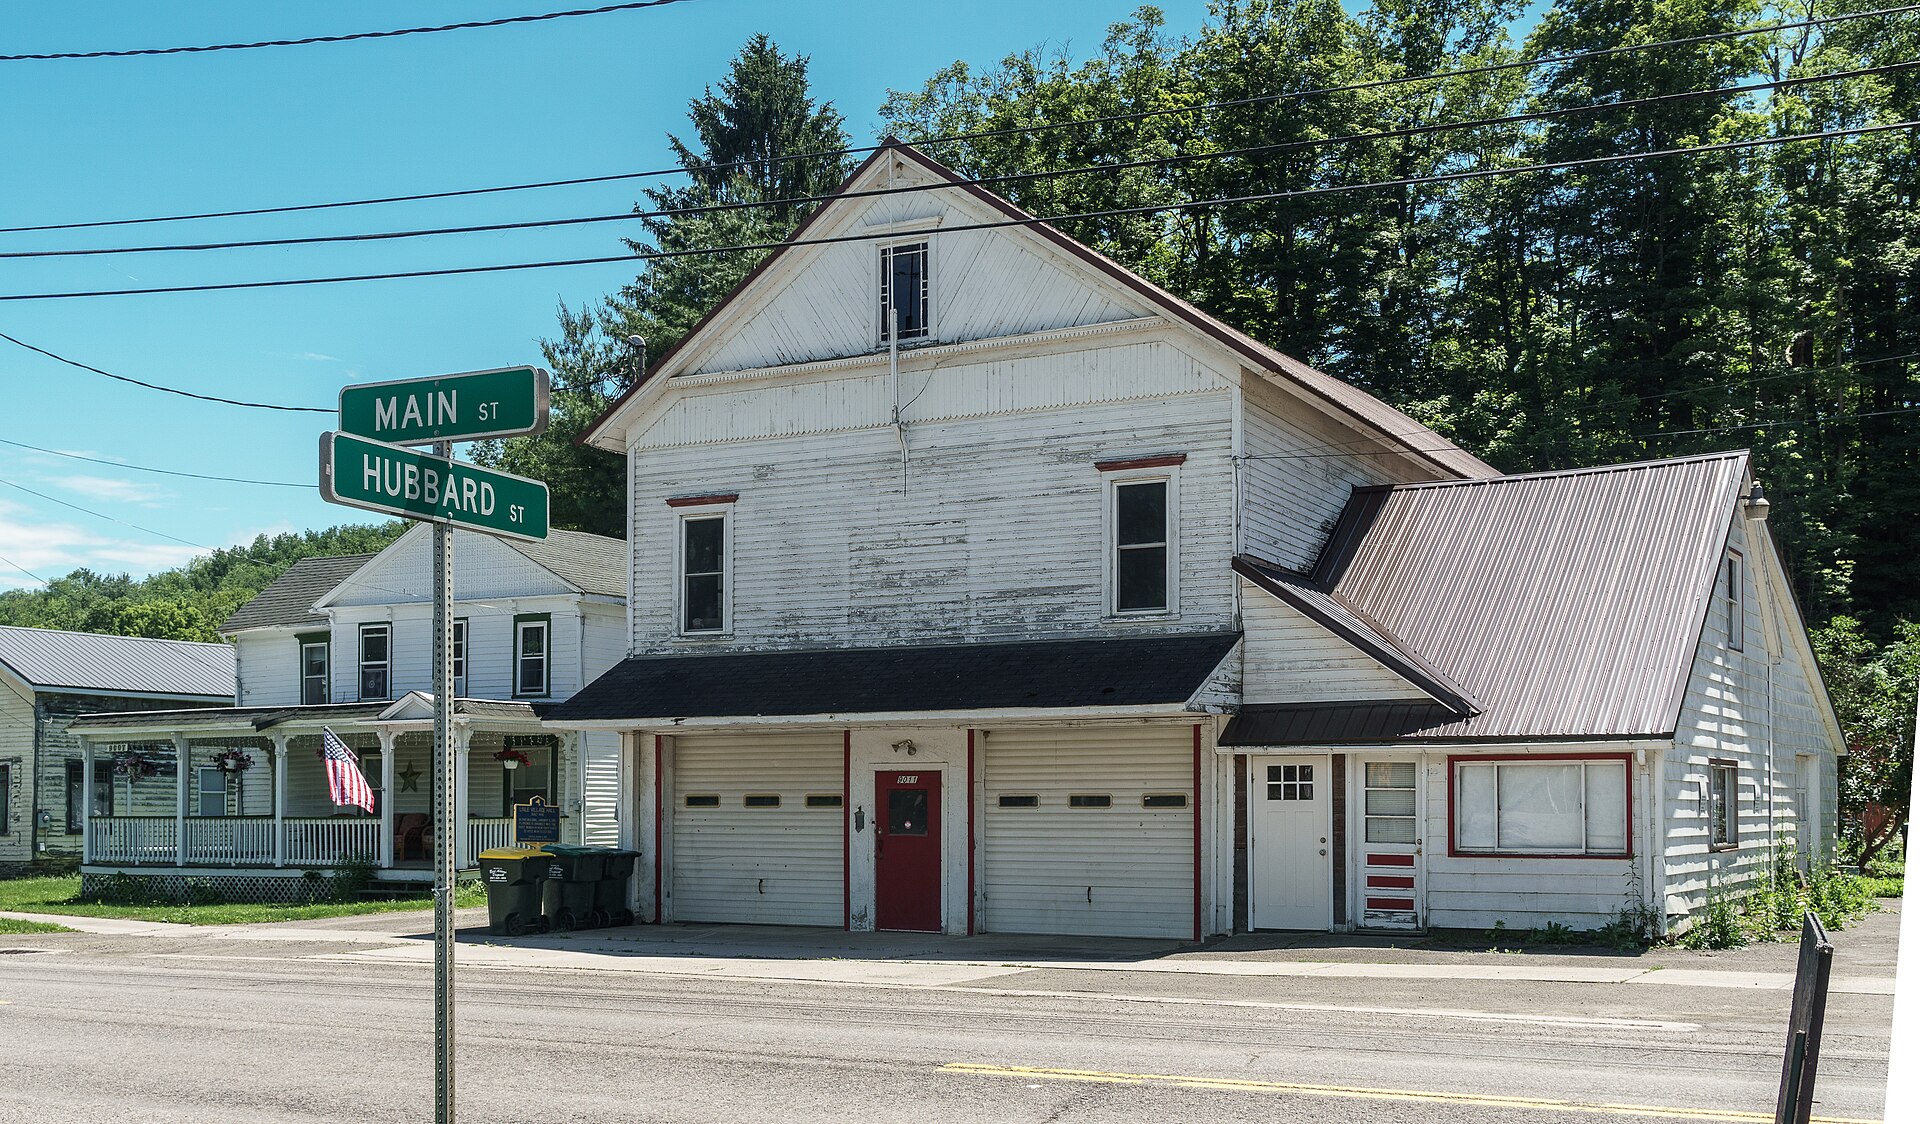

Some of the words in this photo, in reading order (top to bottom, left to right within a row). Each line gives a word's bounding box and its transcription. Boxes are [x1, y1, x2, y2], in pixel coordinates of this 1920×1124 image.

[375, 389, 457, 431] MAIN
[478, 401, 499, 421] ST
[363, 453, 495, 516] HUBBARD
[509, 504, 525, 524] ST
[896, 775, 919, 784] 9011
